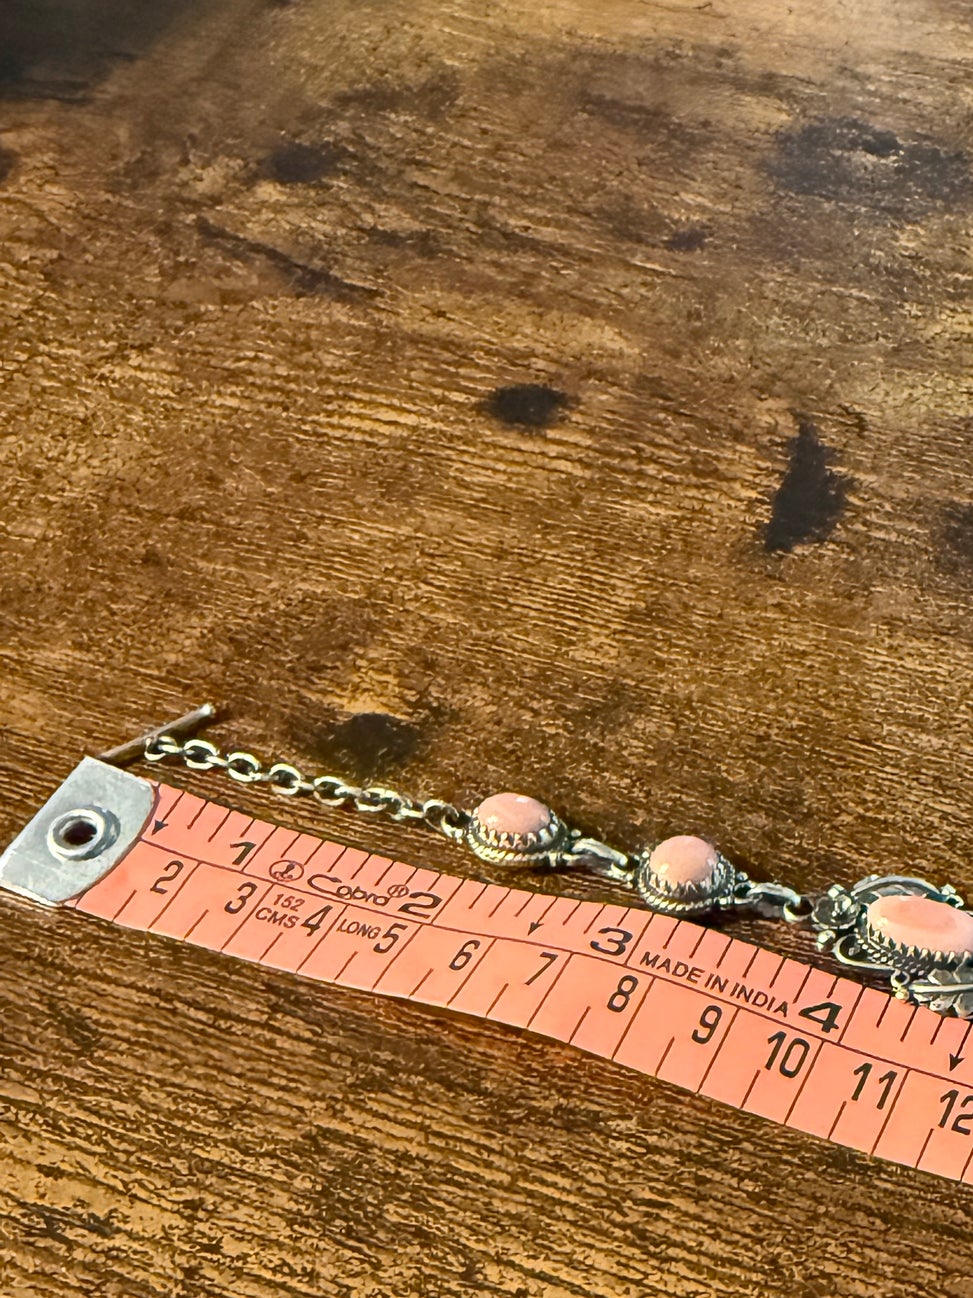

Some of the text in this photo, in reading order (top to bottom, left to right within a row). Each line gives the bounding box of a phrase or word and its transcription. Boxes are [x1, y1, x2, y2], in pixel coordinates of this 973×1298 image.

[229, 841, 257, 866] 1
[149, 860, 184, 896] 2
[224, 881, 258, 914] 3
[273, 893, 306, 913] 152
[397, 891, 443, 919] 2
[255, 907, 301, 929] CMS
[300, 905, 334, 937] 4
[336, 918, 382, 940] LONG
[373, 922, 408, 954] 5
[589, 926, 634, 957] 3
[447, 938, 481, 972] 6
[524, 951, 559, 987] 7
[606, 974, 639, 1013] 8
[639, 950, 789, 1018] MADE IN INDIA
[691, 1005, 723, 1045] 9
[799, 1002, 843, 1033] 4
[764, 1030, 811, 1079] 10
[851, 1062, 898, 1110] 11
